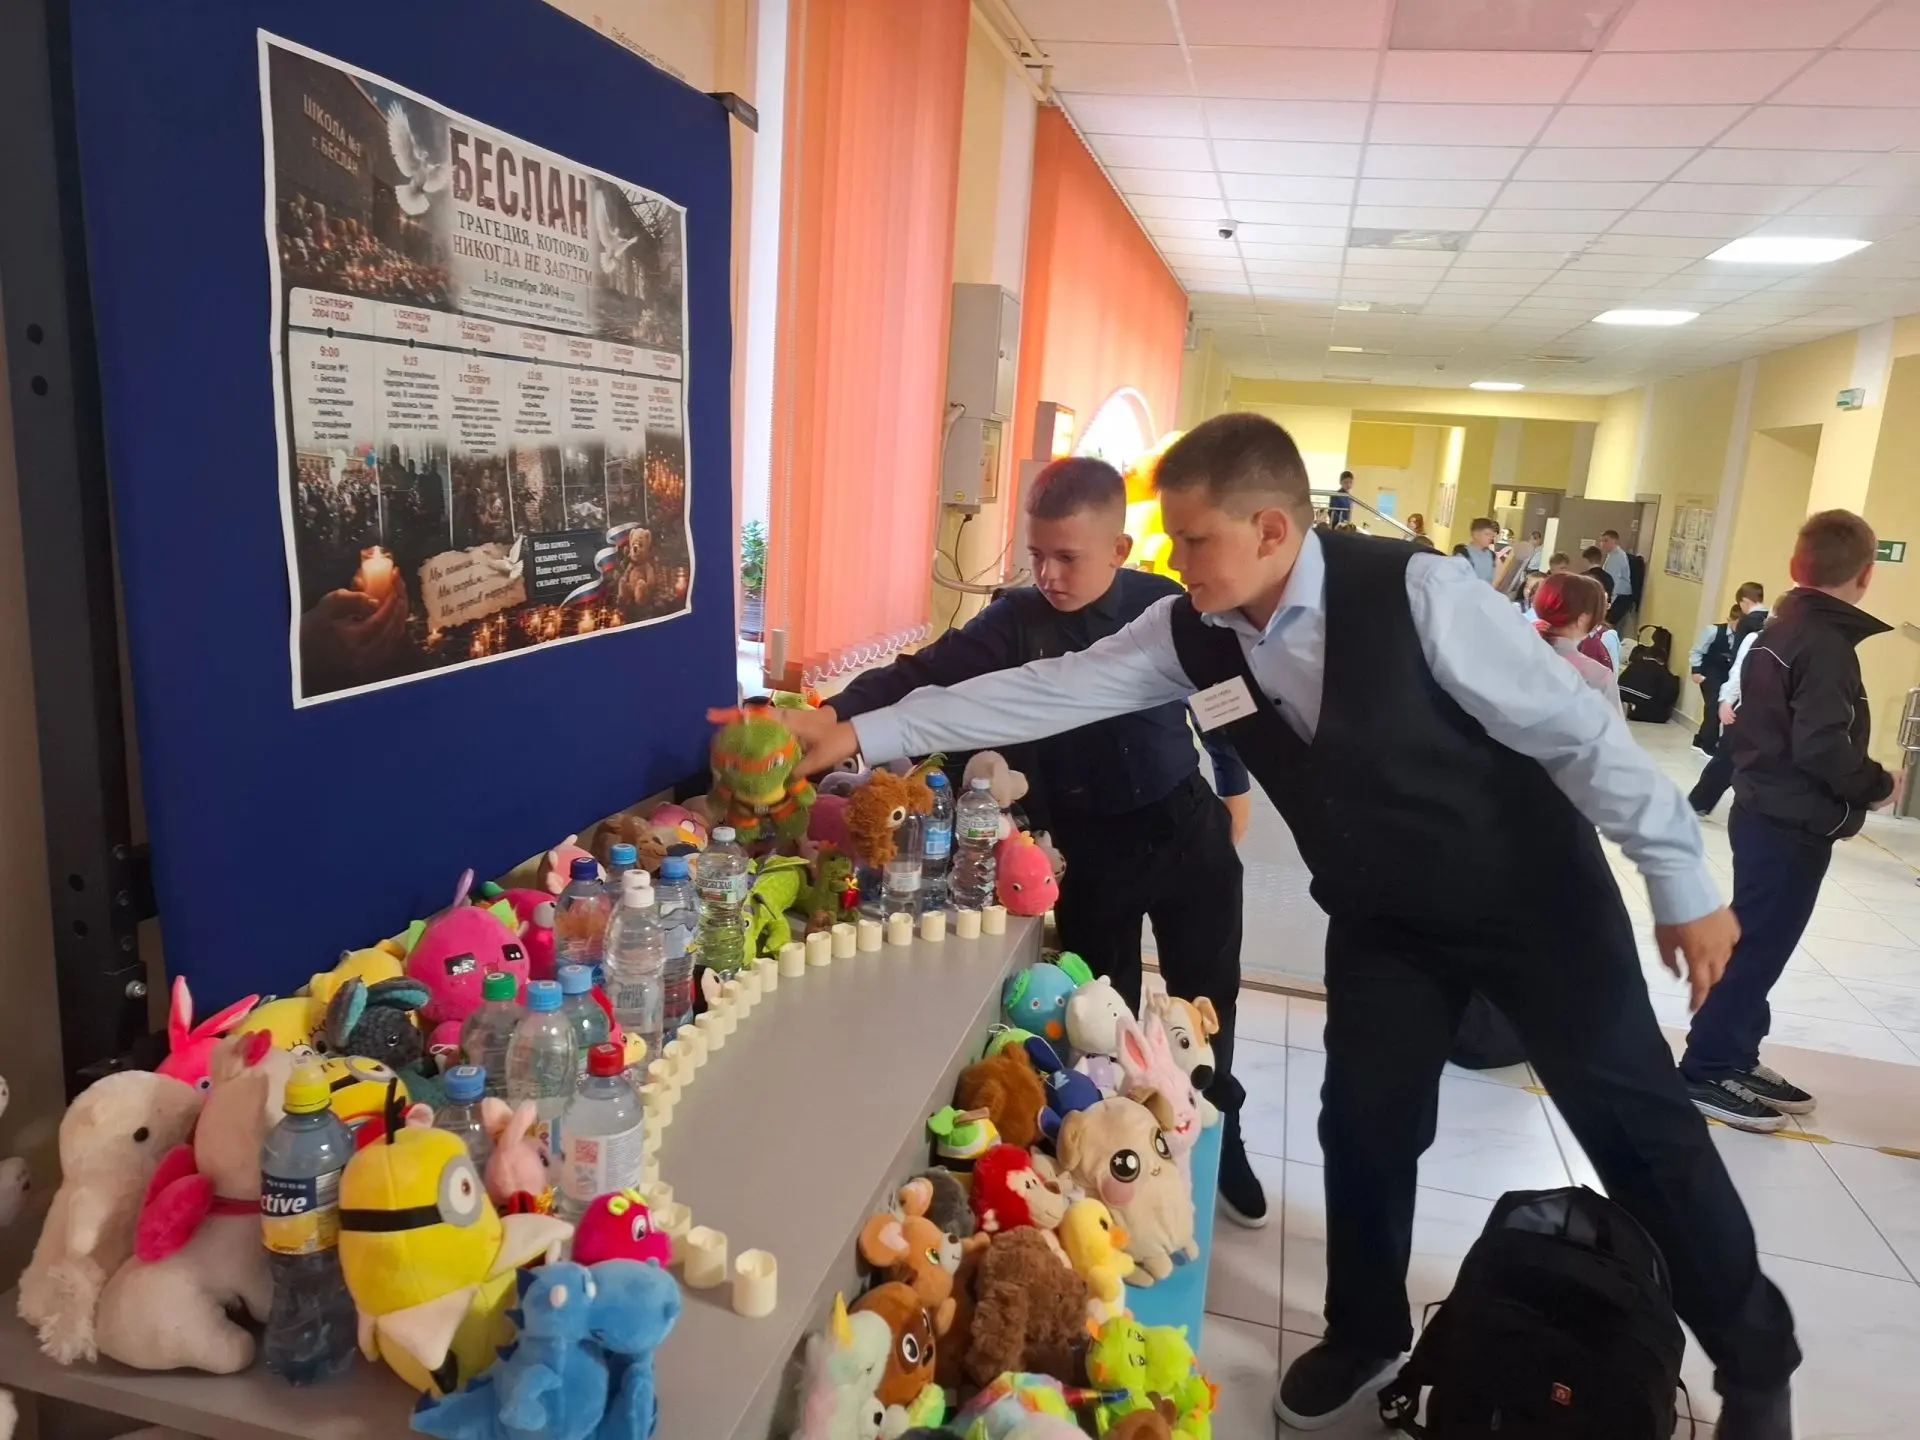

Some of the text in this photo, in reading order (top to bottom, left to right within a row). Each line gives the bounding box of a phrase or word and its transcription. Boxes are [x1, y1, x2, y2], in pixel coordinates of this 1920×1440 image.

[303, 94, 346, 146] ШКОЛА
[321, 136, 358, 177] БЕСЛАН
[449, 126, 589, 240] БЕСЛАН
[457, 210, 590, 263] ТРАГЕДИЯ, КОТОРУЮ
[453, 234, 593, 286] НИКОГДА НЕ ЗАБУДЕМ
[314, 296, 354, 310] СЕНТЯБРЯ
[500, 276, 538, 295] сентября
[539, 281, 560, 299] 2004
[312, 308, 351, 322] 2004 ГОДА
[399, 309, 431, 322] СЕНТЯБРЯ
[320, 345, 339, 358] 9:00
